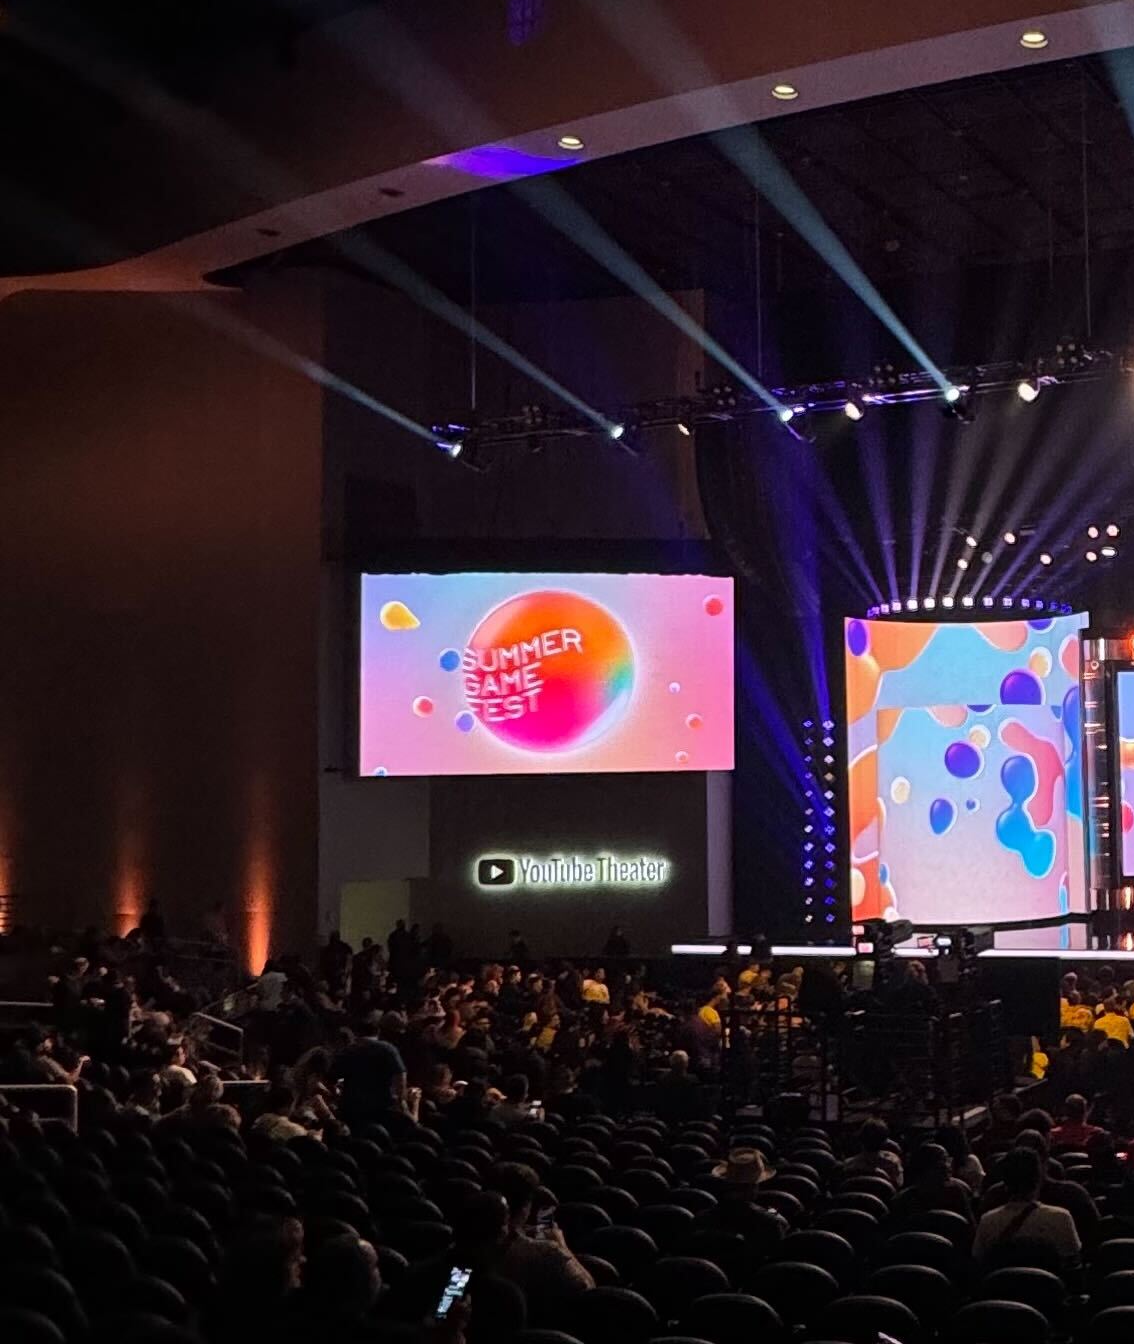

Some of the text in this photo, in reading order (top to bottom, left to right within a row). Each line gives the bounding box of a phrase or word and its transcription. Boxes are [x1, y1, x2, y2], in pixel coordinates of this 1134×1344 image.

[462, 627, 583, 672] SUMMER
[463, 661, 545, 696] GAME
[465, 687, 543, 722] FEST
[519, 856, 666, 884] YouTube Theater
